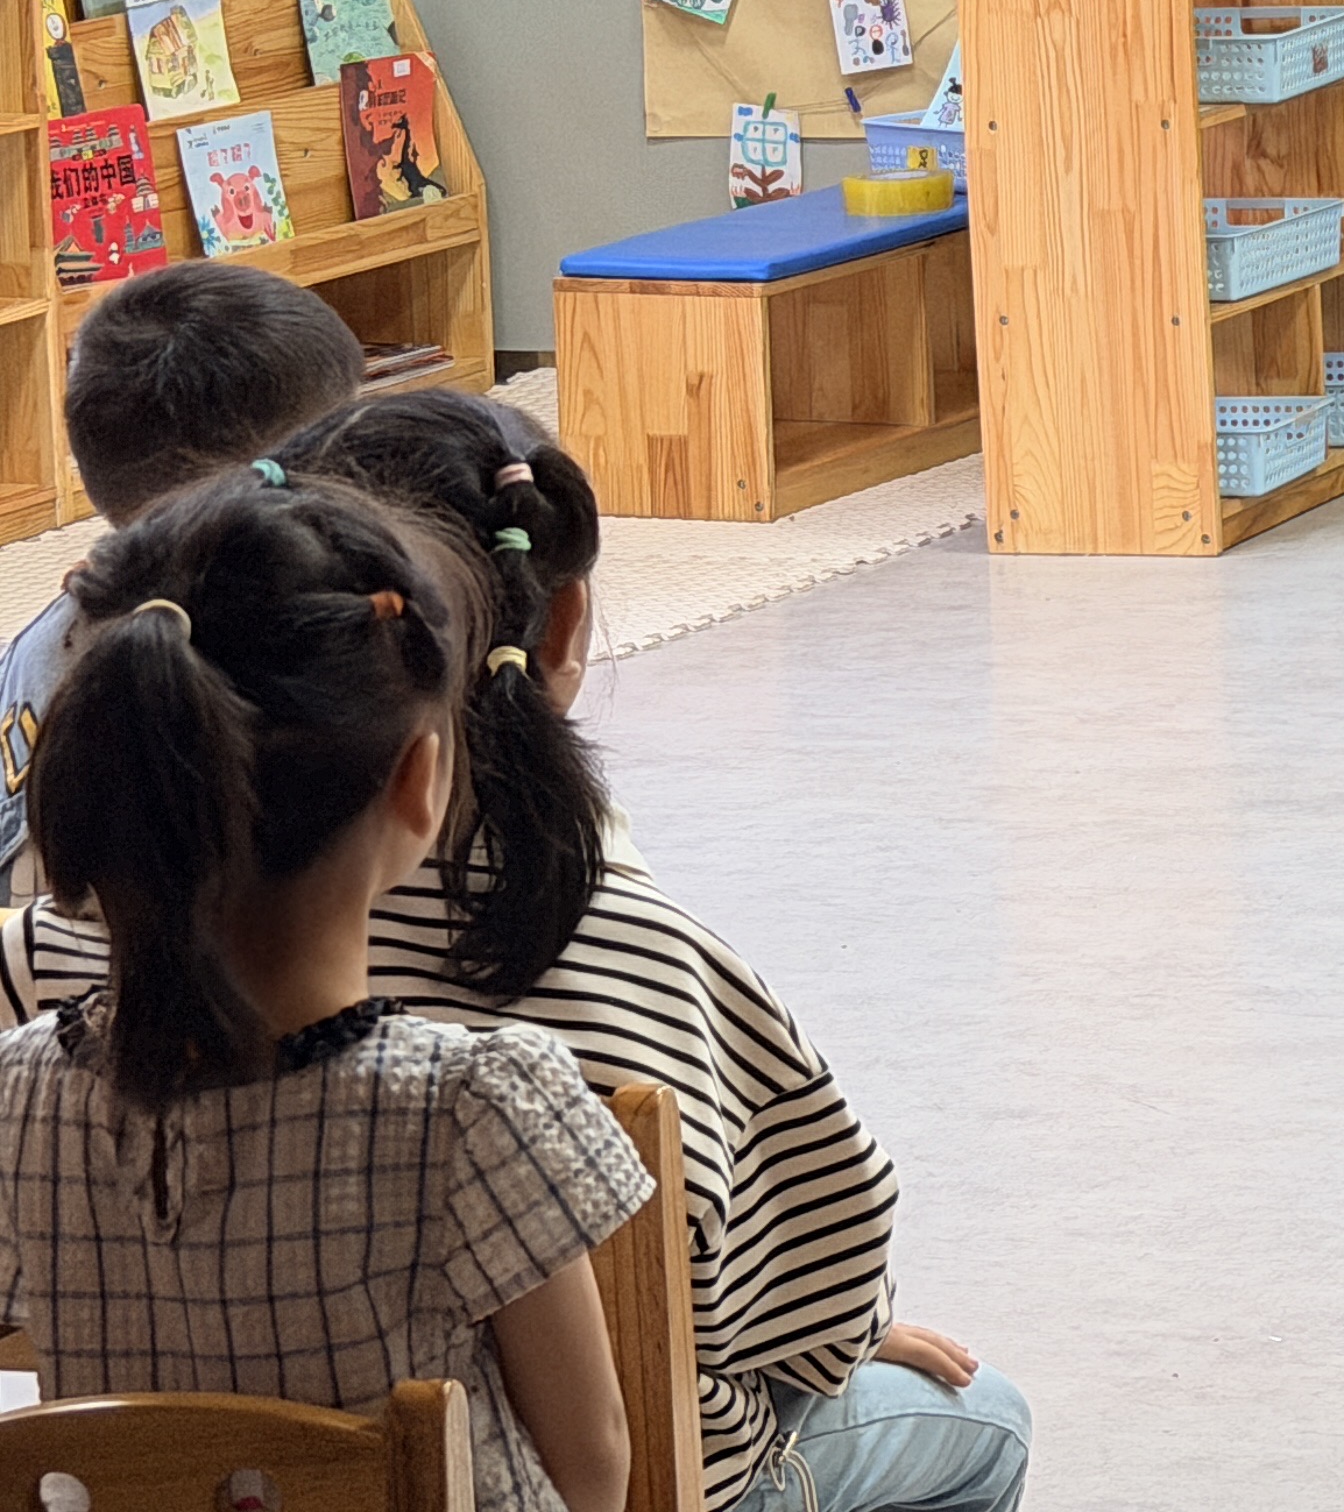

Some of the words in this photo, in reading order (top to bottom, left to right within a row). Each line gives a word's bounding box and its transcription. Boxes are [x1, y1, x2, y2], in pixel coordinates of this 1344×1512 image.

[51, 155, 136, 199] 我们的中国
